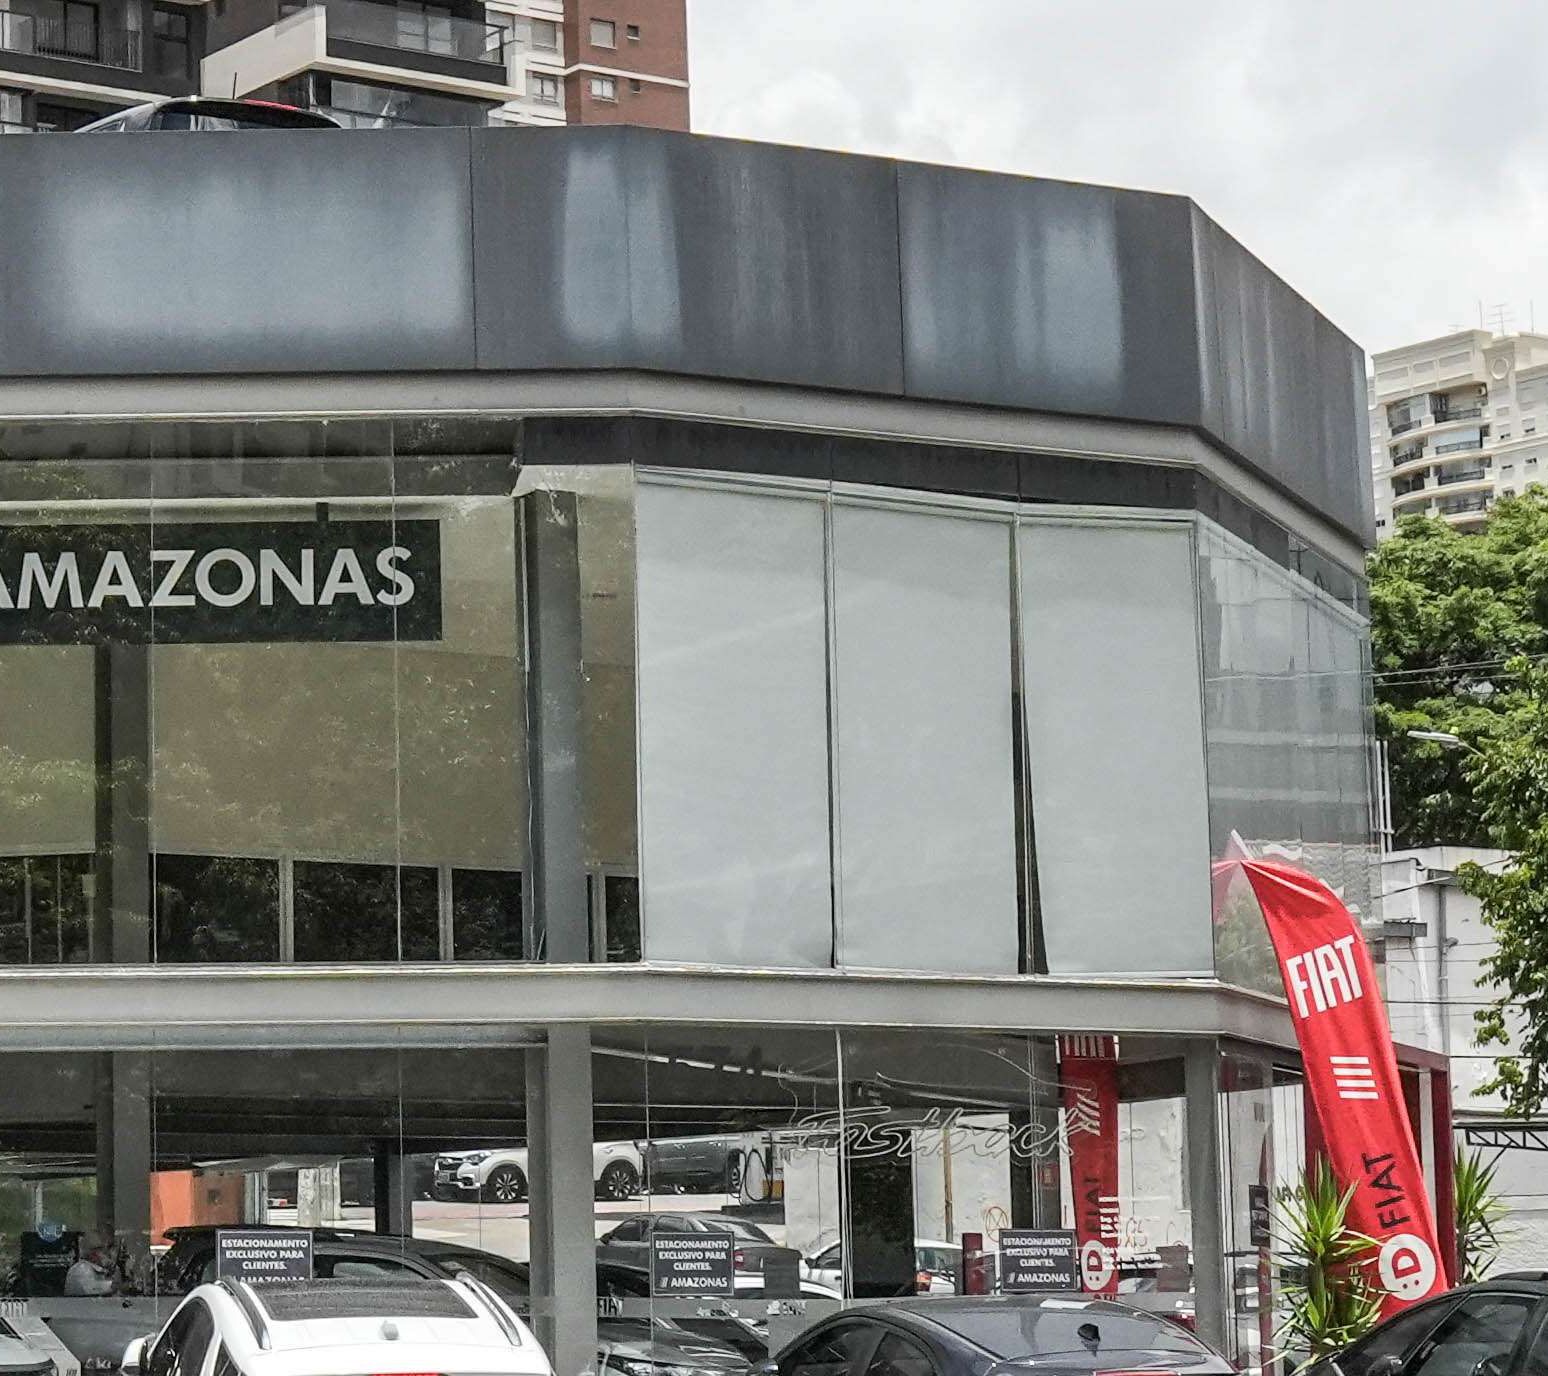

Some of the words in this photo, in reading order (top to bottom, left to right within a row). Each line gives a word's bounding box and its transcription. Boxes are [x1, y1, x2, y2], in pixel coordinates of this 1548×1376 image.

[1286, 934, 1363, 1019] FIAT
[1362, 1152, 1411, 1230] FIAT
[222, 1239, 308, 1248] ESTACIONAMENTO
[655, 1240, 730, 1249] ESTACIONAMENTO
[1003, 1237, 1071, 1245] ESTACIONAMENTO
[226, 1250, 277, 1258] EXCLUSIVO
[280, 1250, 304, 1258] PARA
[659, 1251, 704, 1260] EXCLUSIVO
[705, 1251, 726, 1260] PARA
[242, 1261, 287, 1270] CLIENTES.
[670, 1277, 728, 1288] AMAZONAS
[1017, 1273, 1071, 1283] AMAZONAS
